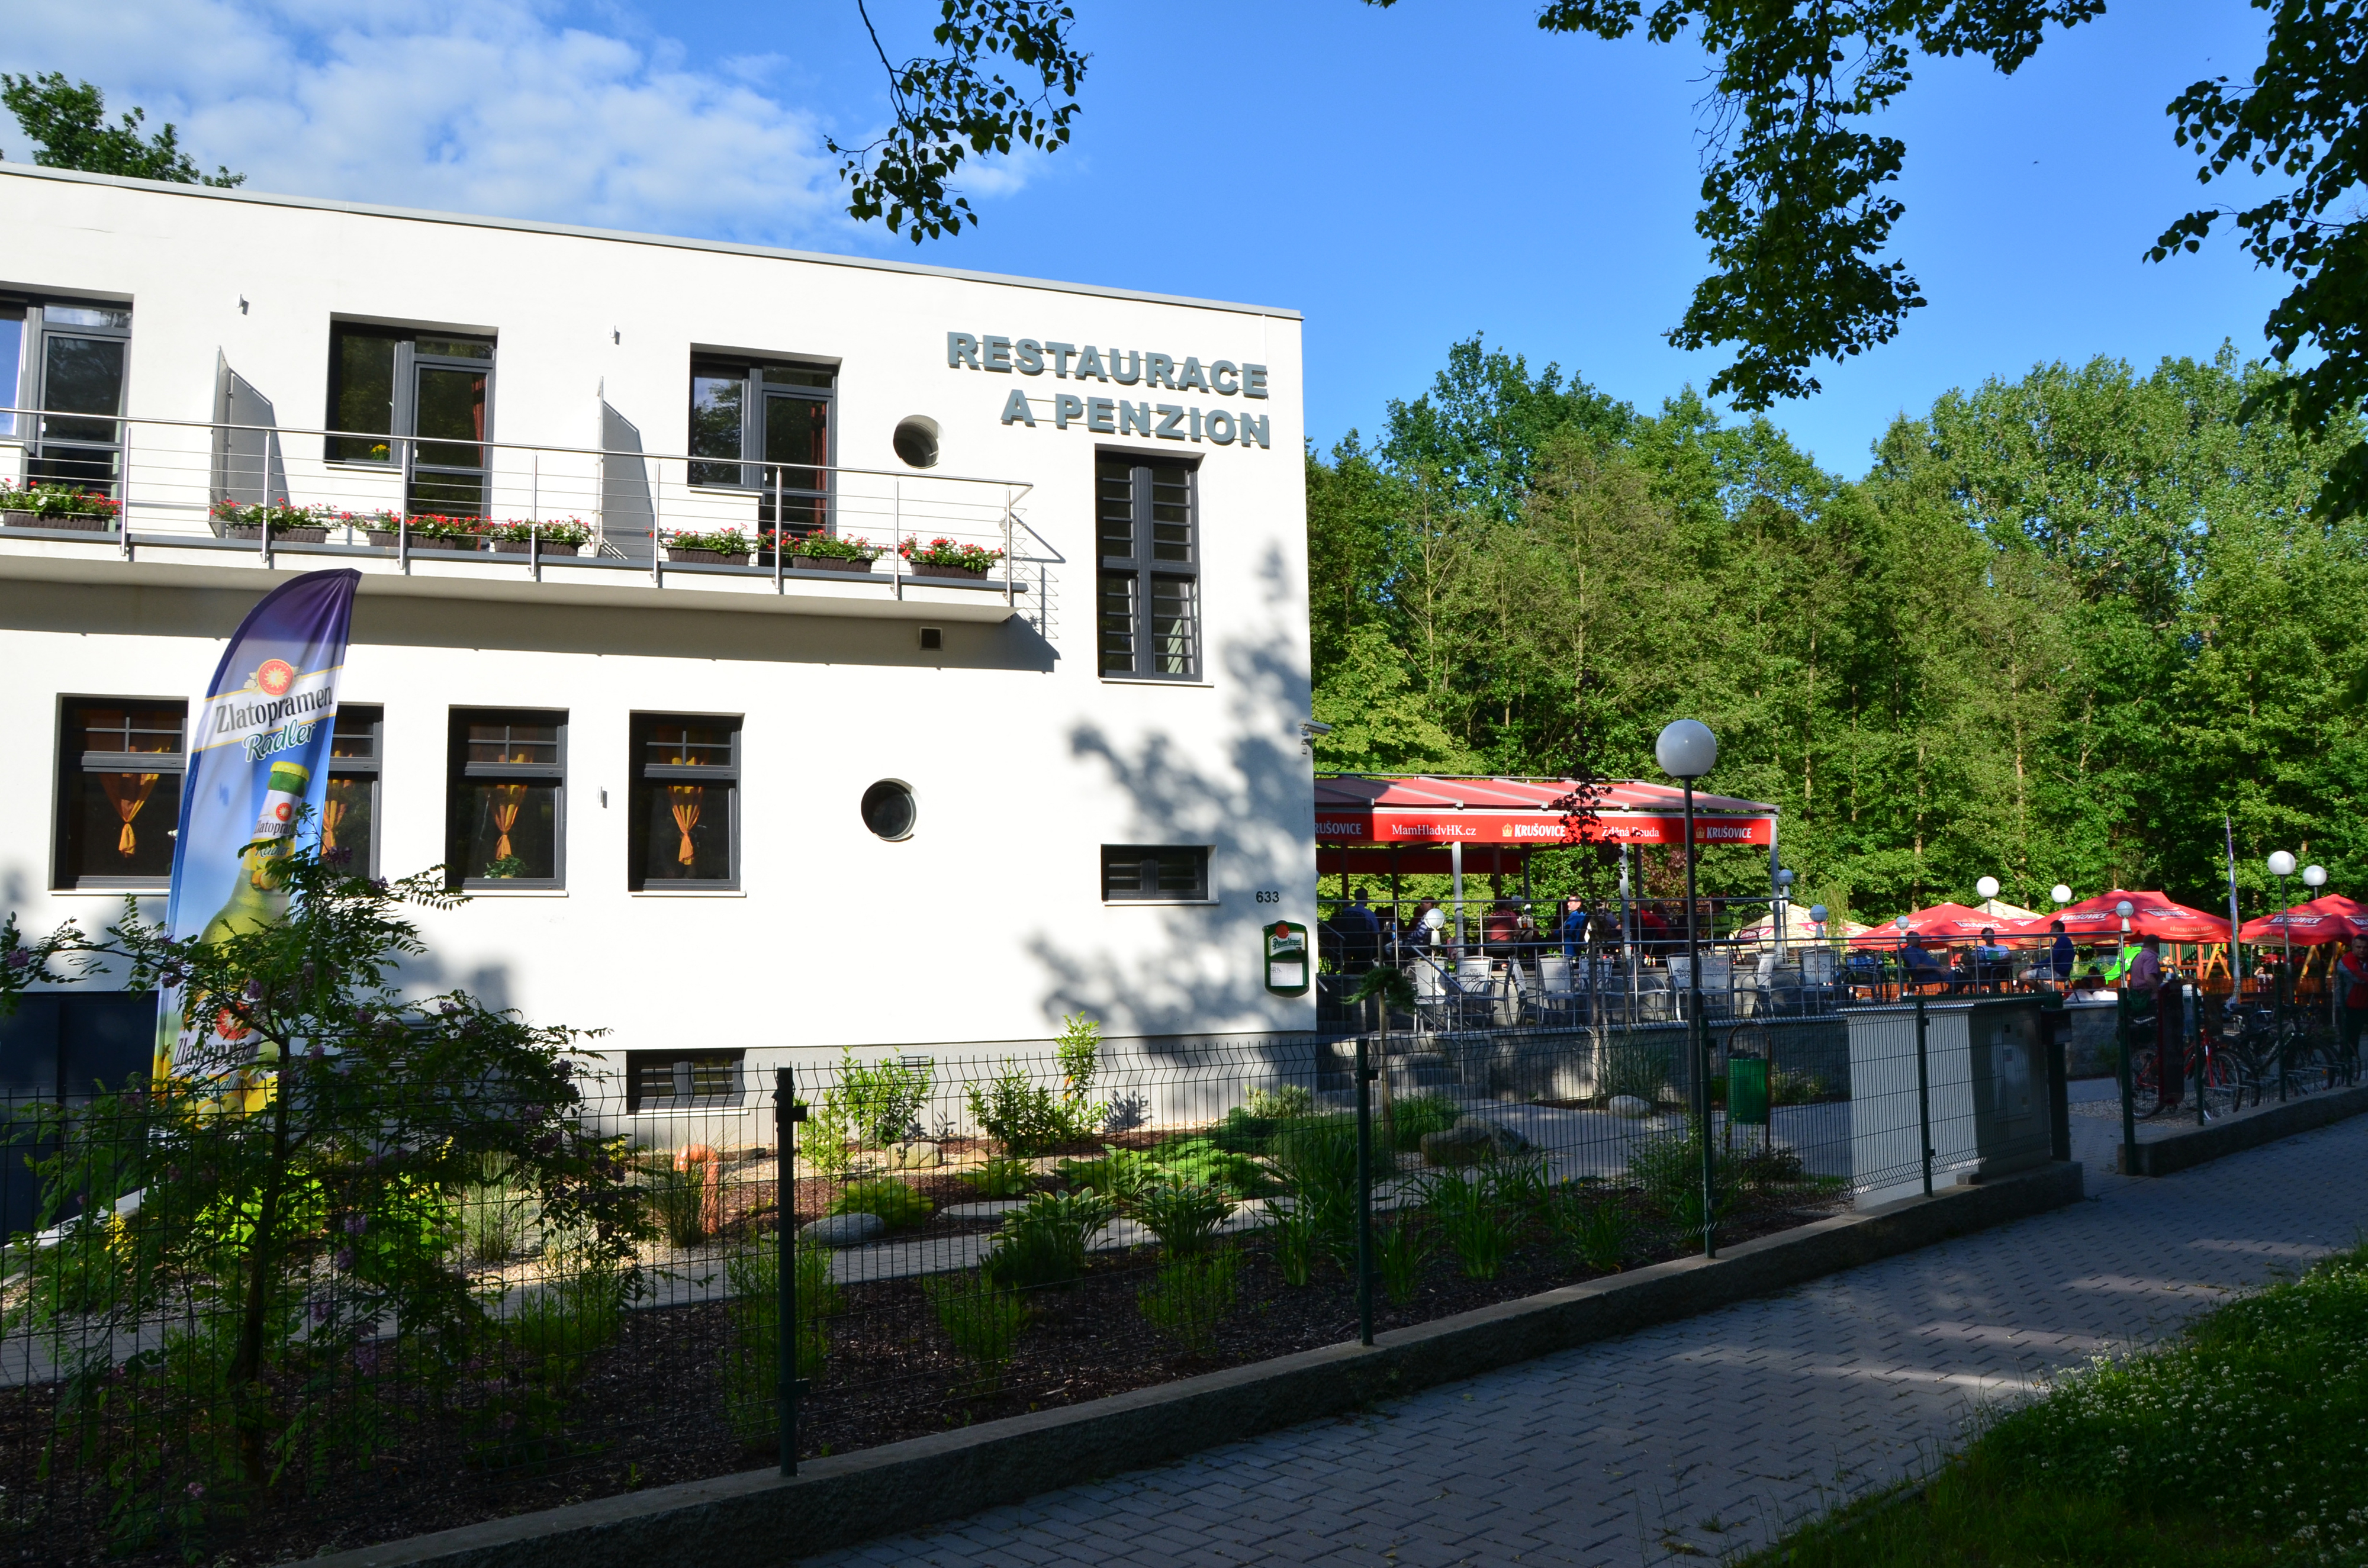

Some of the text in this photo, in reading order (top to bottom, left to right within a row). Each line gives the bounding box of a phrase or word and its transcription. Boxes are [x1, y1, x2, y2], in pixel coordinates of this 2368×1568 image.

[947, 331, 1268, 400] RESTAURACE
[1001, 389, 1270, 449] A PENZION
[216, 686, 333, 734] Zlatopramen
[243, 719, 316, 762] Radler
[1314, 820, 1362, 835] RUŠOVICE
[1392, 824, 1476, 836] MamHladvHK.cz
[1514, 823, 1566, 837] KRUŠOVICE
[1707, 825, 1752, 839] KRUŠOVICE
[1256, 890, 1279, 903] 633
